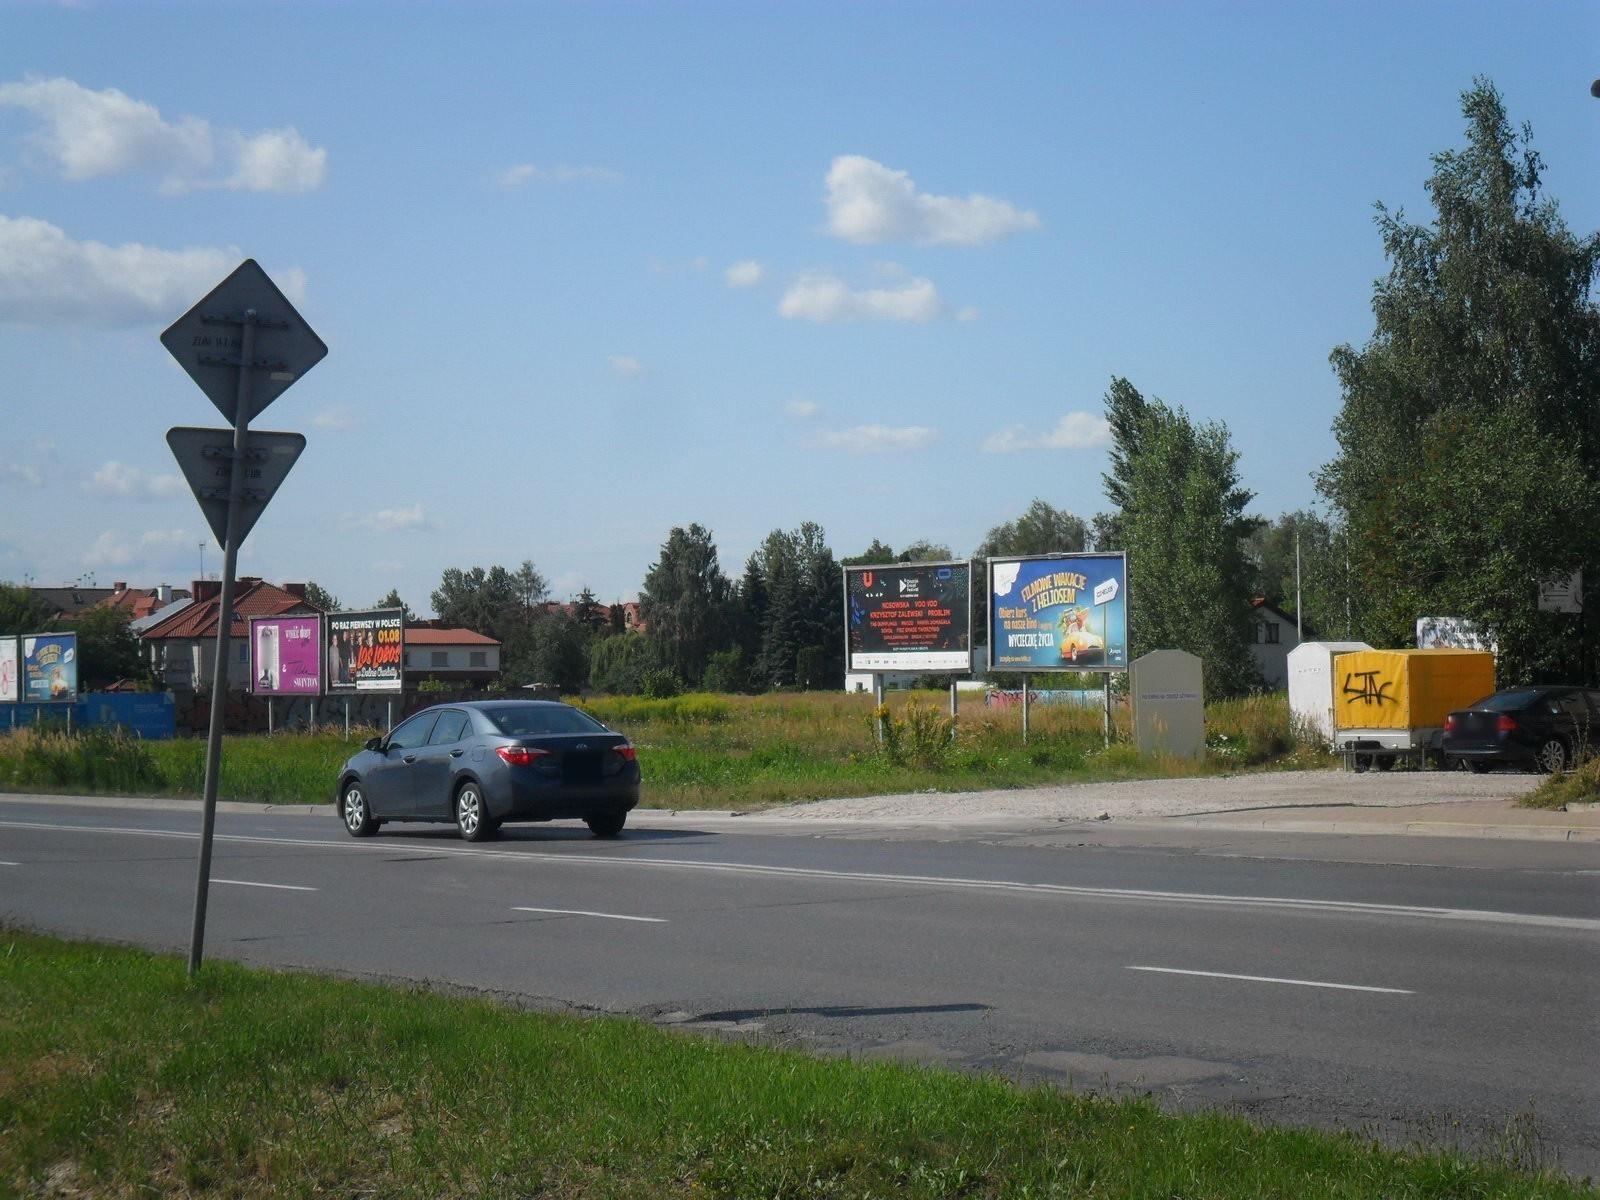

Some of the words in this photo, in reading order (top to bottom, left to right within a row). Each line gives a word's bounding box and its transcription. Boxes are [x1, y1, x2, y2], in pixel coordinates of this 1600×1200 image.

[1021, 574, 1053, 603] FILMOWE
[1053, 572, 1087, 591] WAKACJE
[1032, 598, 1038, 613] Z
[1037, 589, 1076, 610] HELIOSEM
[870, 611, 897, 619] KRZYSZTOF
[897, 610, 923, 618] ZALEWSKI
[331, 621, 339, 630] PO
[339, 621, 350, 630] RAZ
[350, 620, 375, 630] PIERWSZY
[375, 620, 381, 628] W
[381, 618, 401, 628] POLSCE
[378, 629, 400, 643] 01.08
[1008, 634, 1038, 649] WYCIECZKĘ
[1038, 631, 1054, 647] ŻYCIA
[357, 645, 373, 669] LOS
[372, 644, 401, 668] LOBOS
